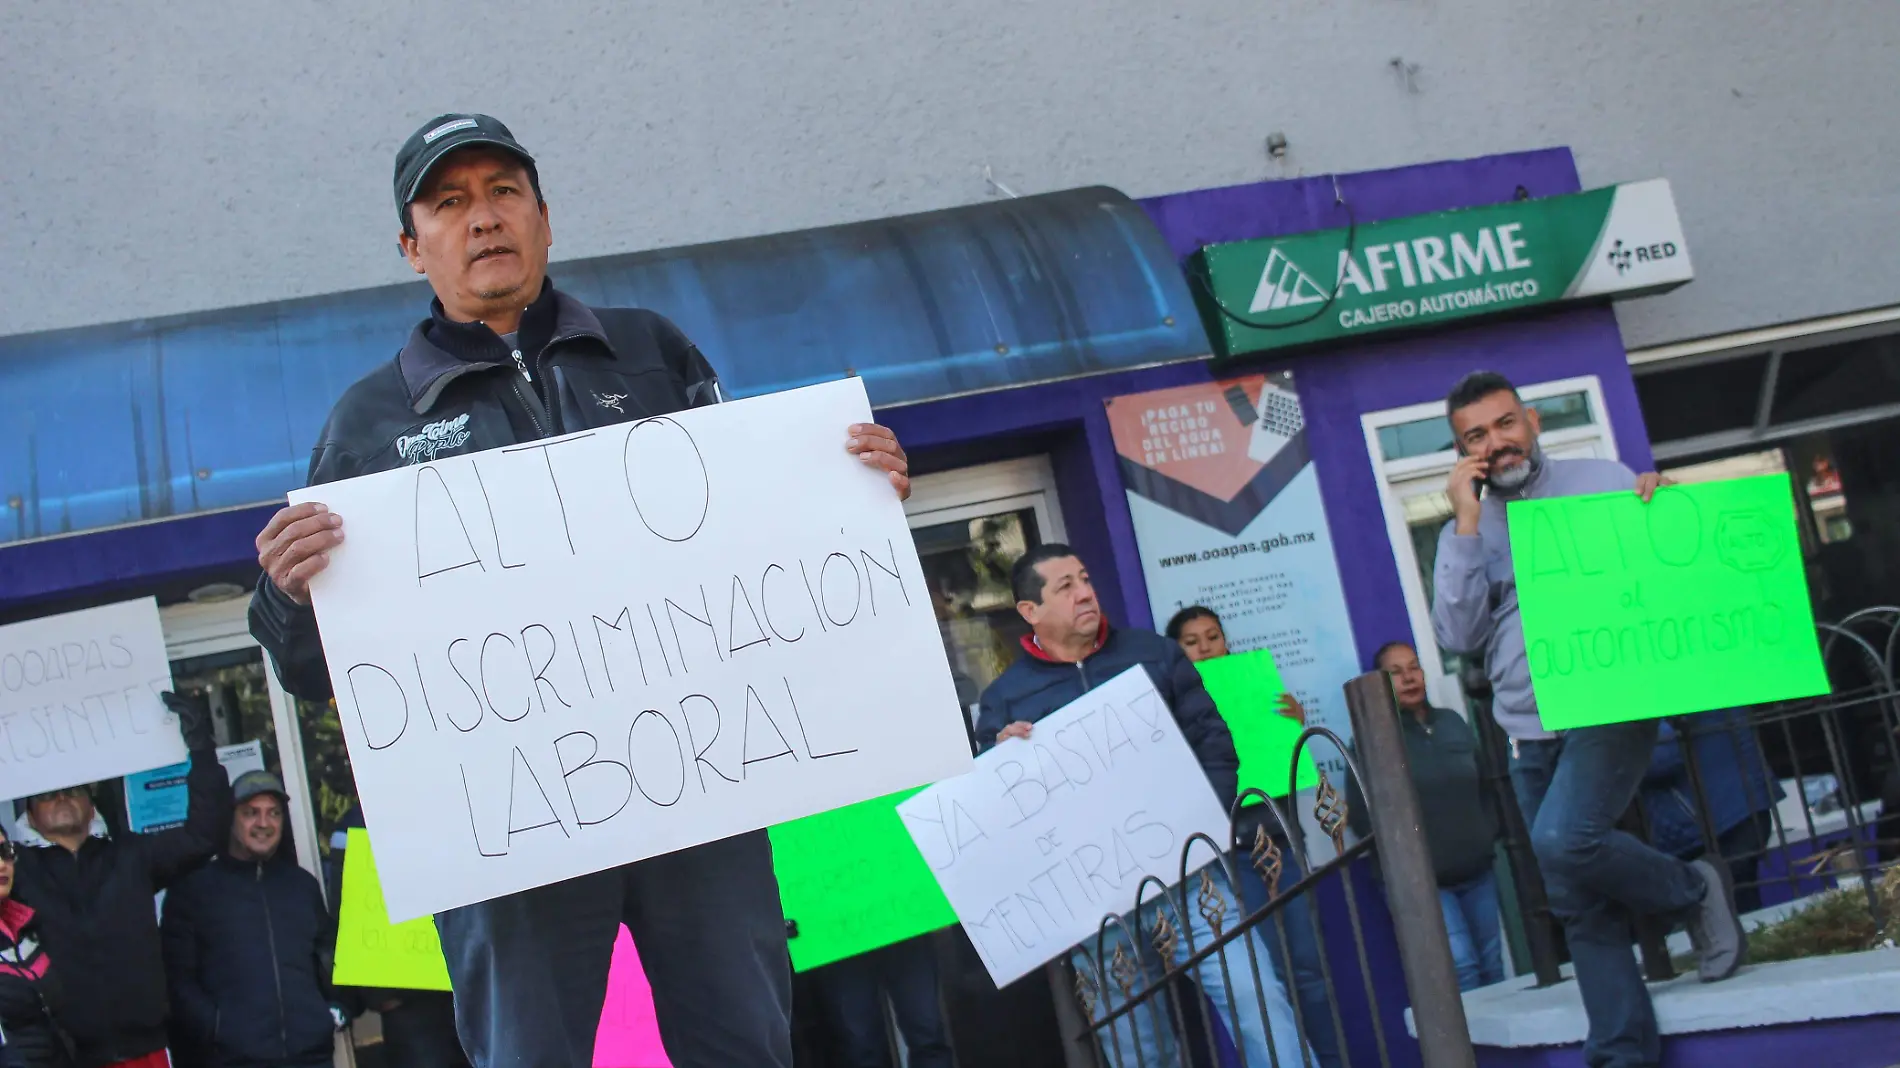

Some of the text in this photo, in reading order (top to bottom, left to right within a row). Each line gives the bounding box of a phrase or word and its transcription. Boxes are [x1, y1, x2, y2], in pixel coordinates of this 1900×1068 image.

[1336, 222, 1532, 301] AFIRME
[1636, 241, 1677, 264] RED
[1339, 277, 1539, 329] CAJERO AUTOMÁTICO
[1149, 416, 1209, 436] RECIBO
[1195, 401, 1217, 415] TU
[1142, 428, 1223, 452] DEL AGUA
[1145, 451, 1168, 467] EN
[414, 416, 709, 588] ALTO
[1159, 531, 1316, 569] www.ooapas.gob.mx
[1529, 487, 1702, 583] ALTO
[1, 634, 134, 694] OOAPAS
[346, 526, 912, 750] DISCRIMINACIÓN
[459, 676, 858, 858] LABORAL
[906, 793, 990, 872] YA
[994, 688, 1166, 829] BASTA!
[1035, 825, 1065, 857] DE
[967, 808, 1175, 970] MENTIRAS
